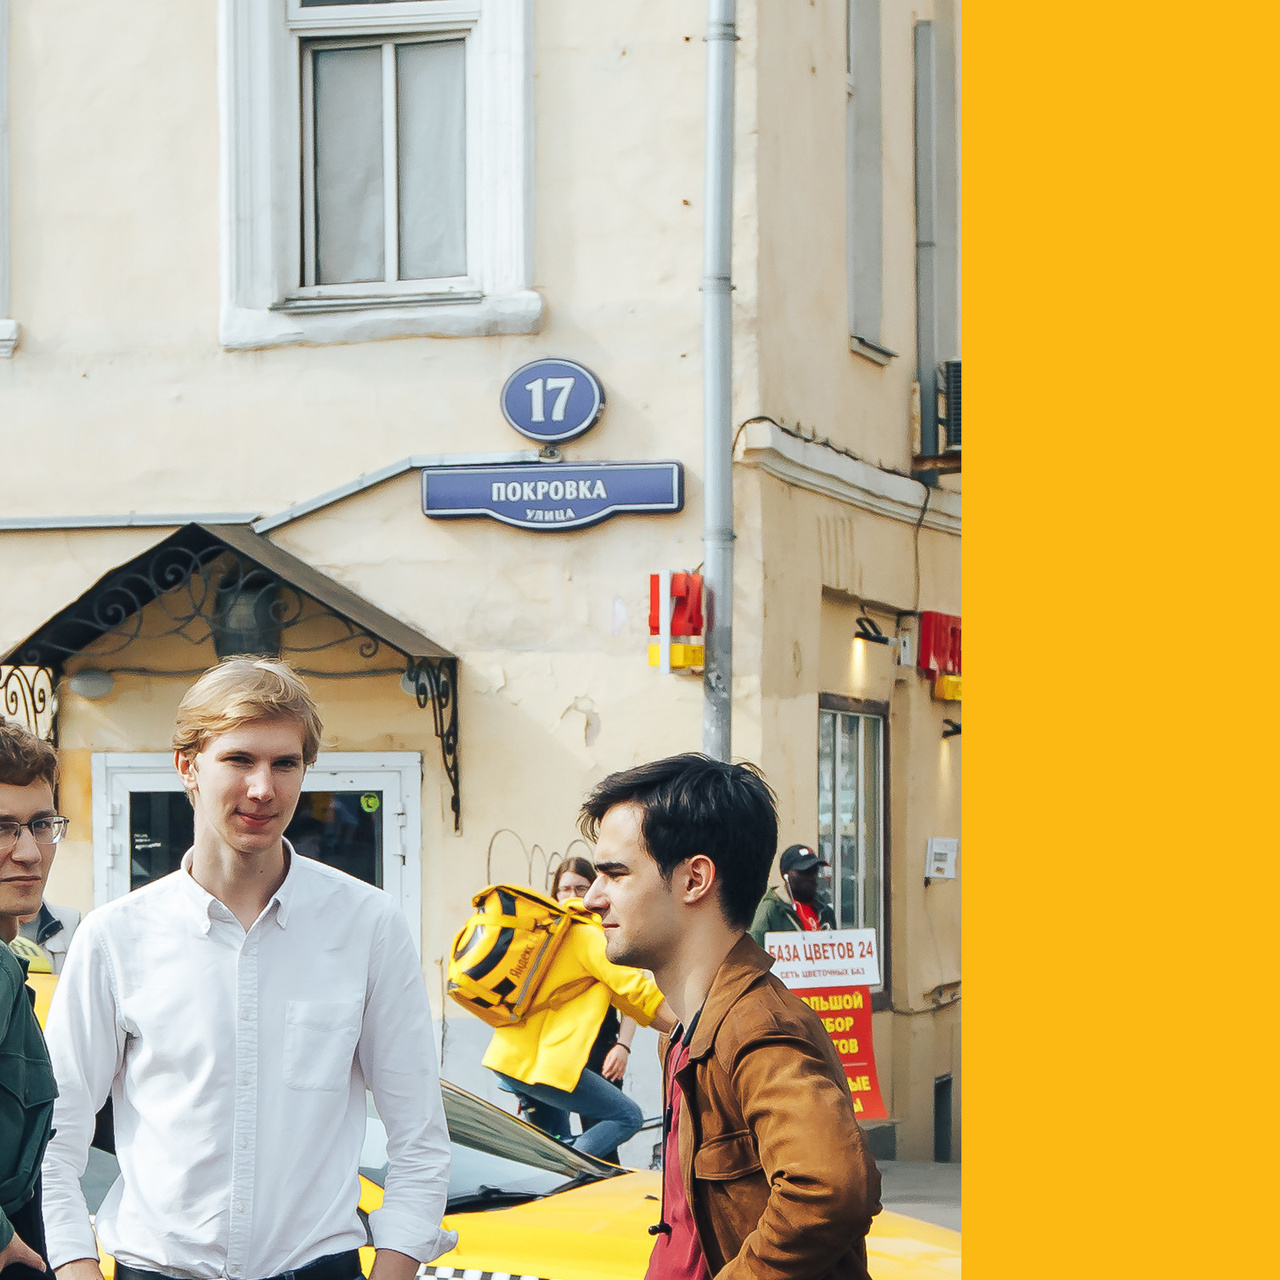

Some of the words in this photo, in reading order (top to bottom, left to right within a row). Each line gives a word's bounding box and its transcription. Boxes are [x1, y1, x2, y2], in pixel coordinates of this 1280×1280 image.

[524, 377, 576, 423] 17
[491, 480, 608, 502] ПОКРОВКА
[525, 508, 576, 521] УЛИЦА
[769, 944, 800, 962] БАЗА
[804, 942, 855, 964] ЦВЕТОВ
[859, 941, 874, 958] 24
[780, 971, 799, 979] СЕТЬ
